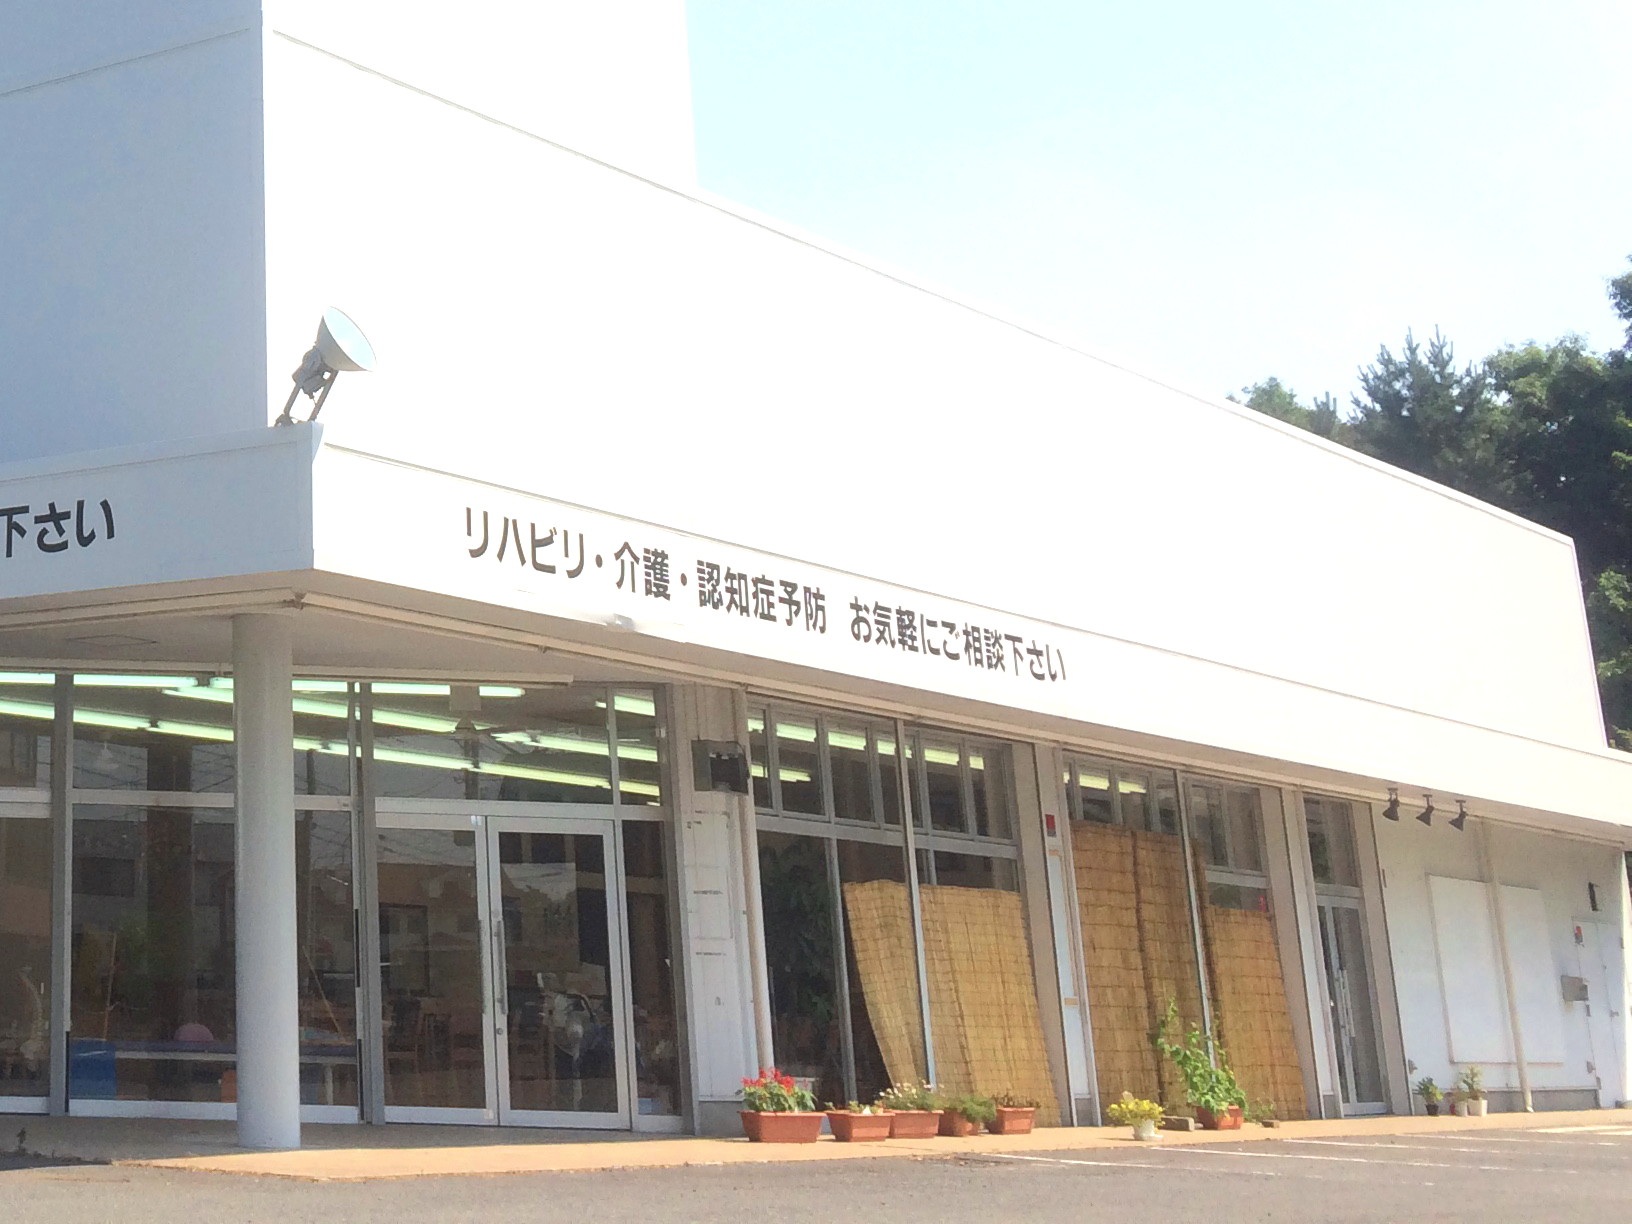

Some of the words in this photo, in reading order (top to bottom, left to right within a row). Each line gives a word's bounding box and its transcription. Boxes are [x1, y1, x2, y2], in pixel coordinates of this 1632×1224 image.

[849, 595, 1067, 683] お気軽にご相談下さい
